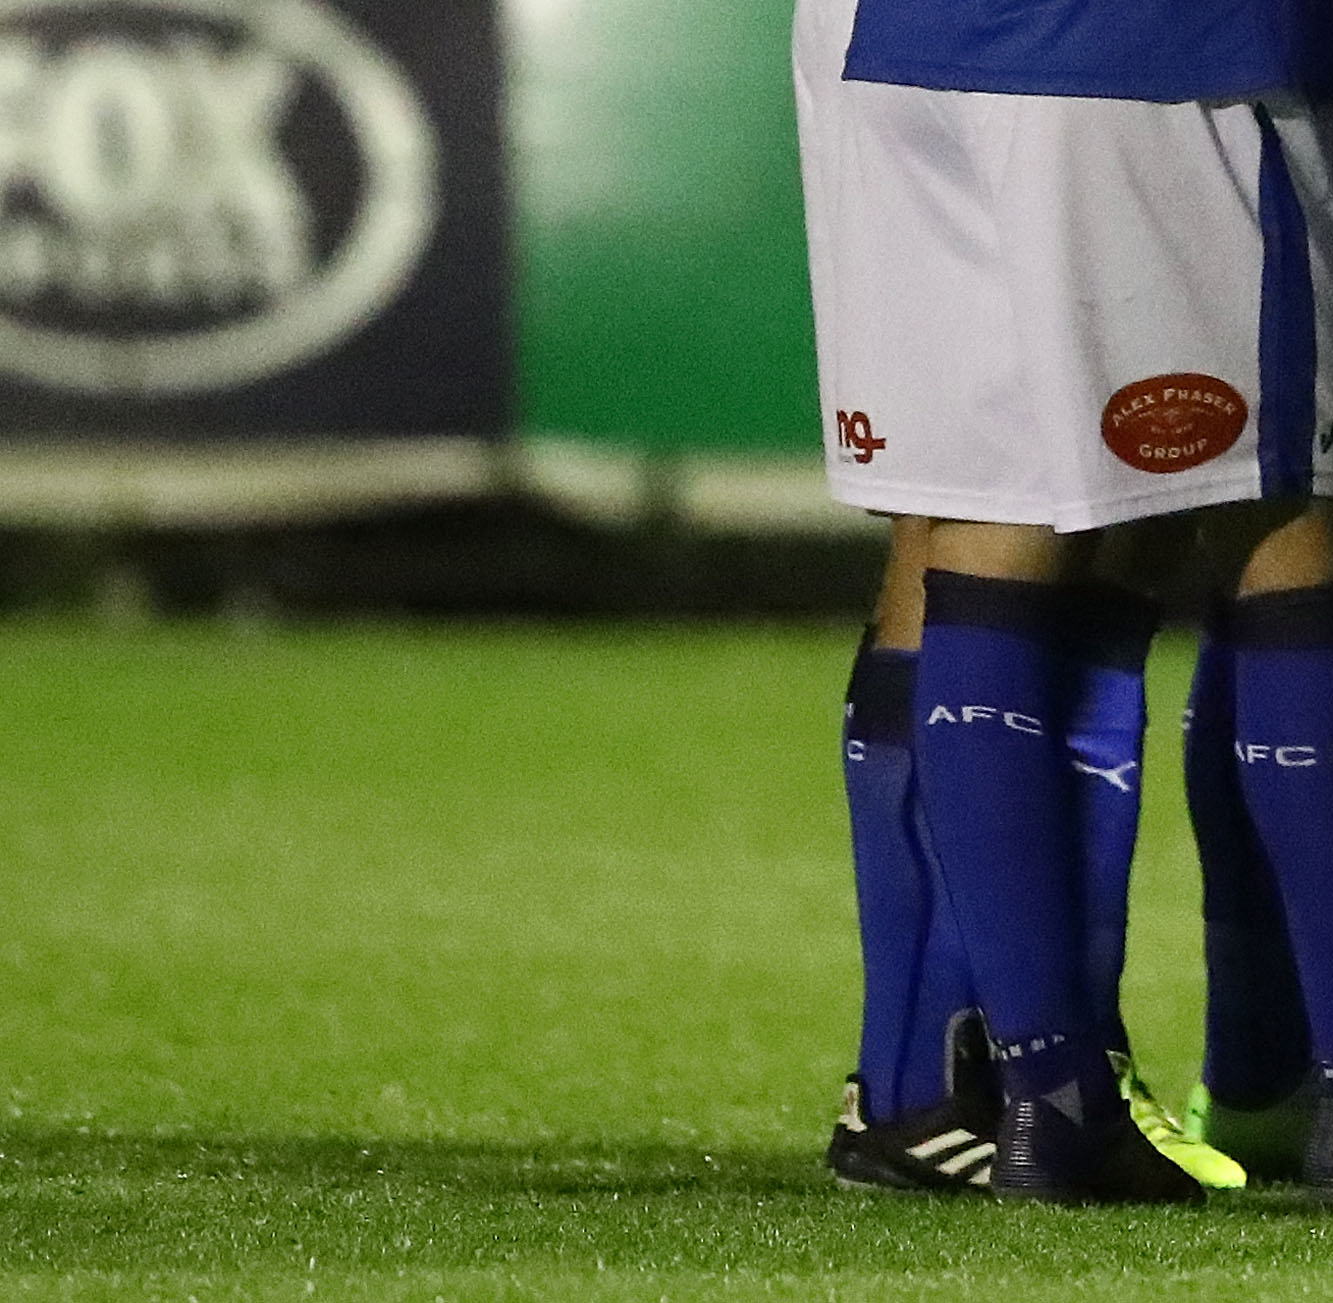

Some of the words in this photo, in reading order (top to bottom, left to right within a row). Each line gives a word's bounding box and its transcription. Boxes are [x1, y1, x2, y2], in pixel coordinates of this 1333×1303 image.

[1112, 393, 1157, 426] ALEX
[1138, 437, 1209, 460] GROUP
[926, 705, 1044, 736] AFC
